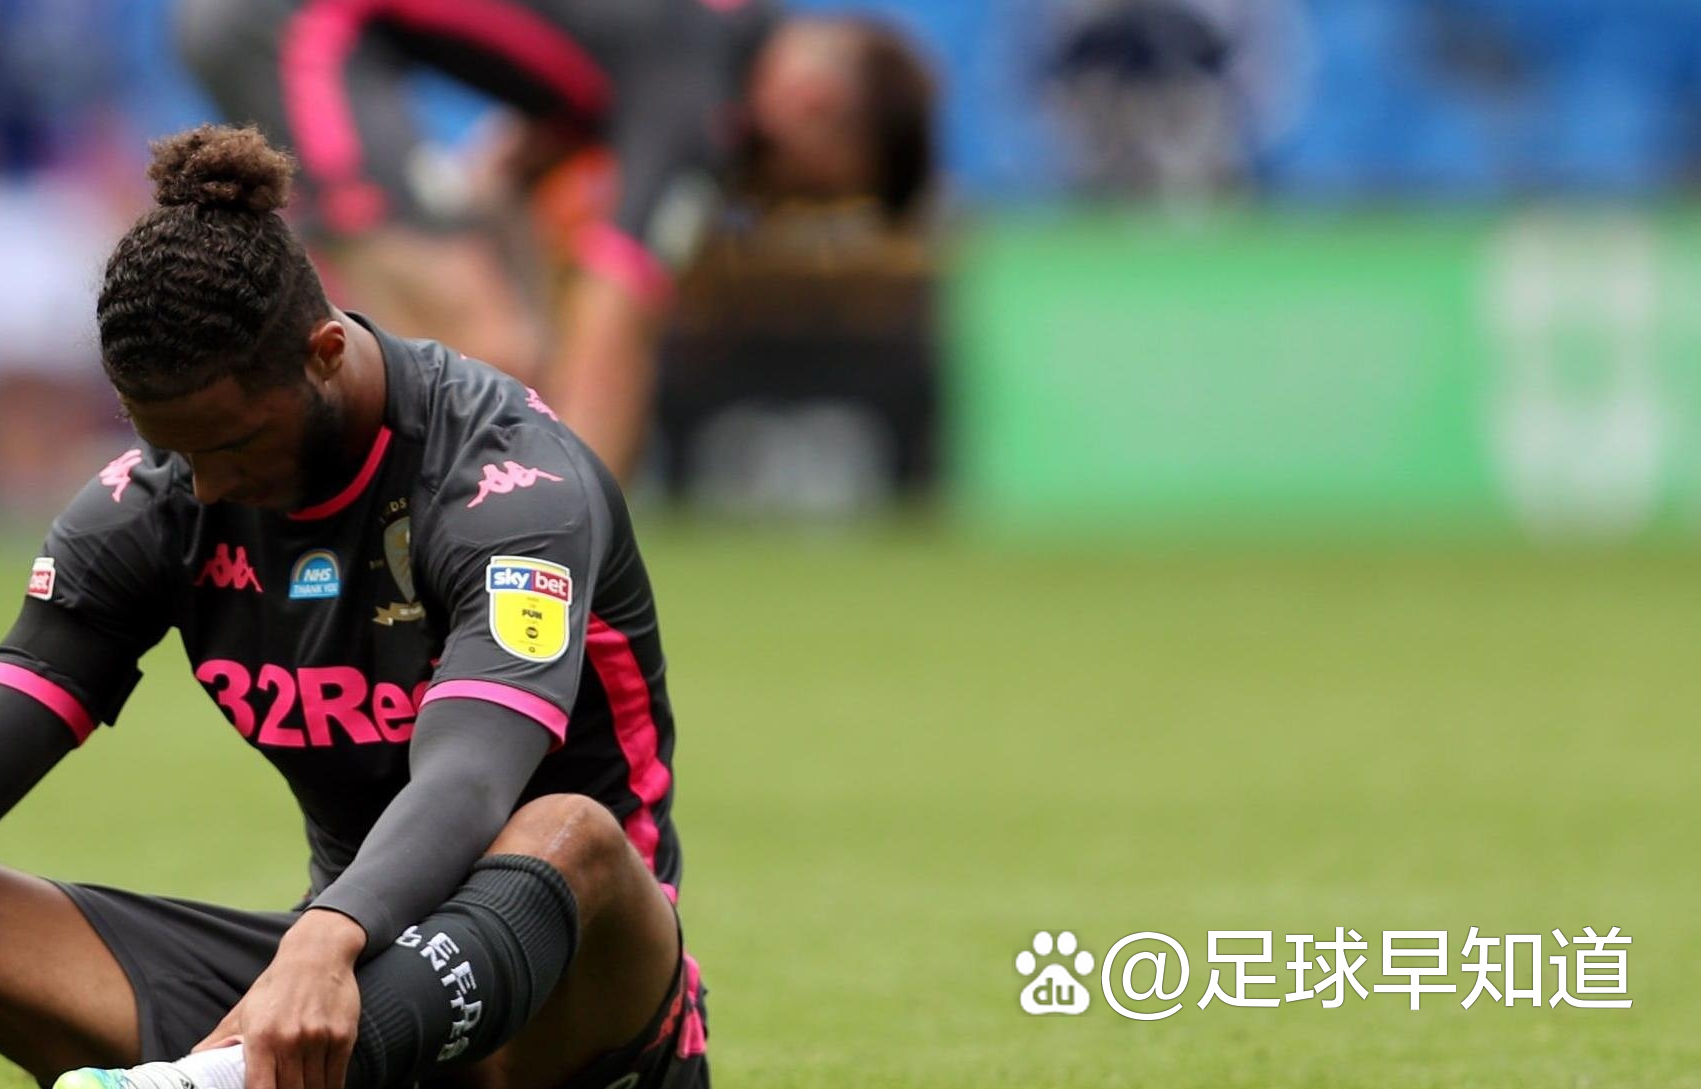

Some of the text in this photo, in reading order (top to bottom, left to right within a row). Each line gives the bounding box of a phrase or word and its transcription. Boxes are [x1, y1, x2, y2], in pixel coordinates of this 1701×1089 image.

[494, 568, 567, 596] sky bet
[196, 659, 442, 747] 32Re
